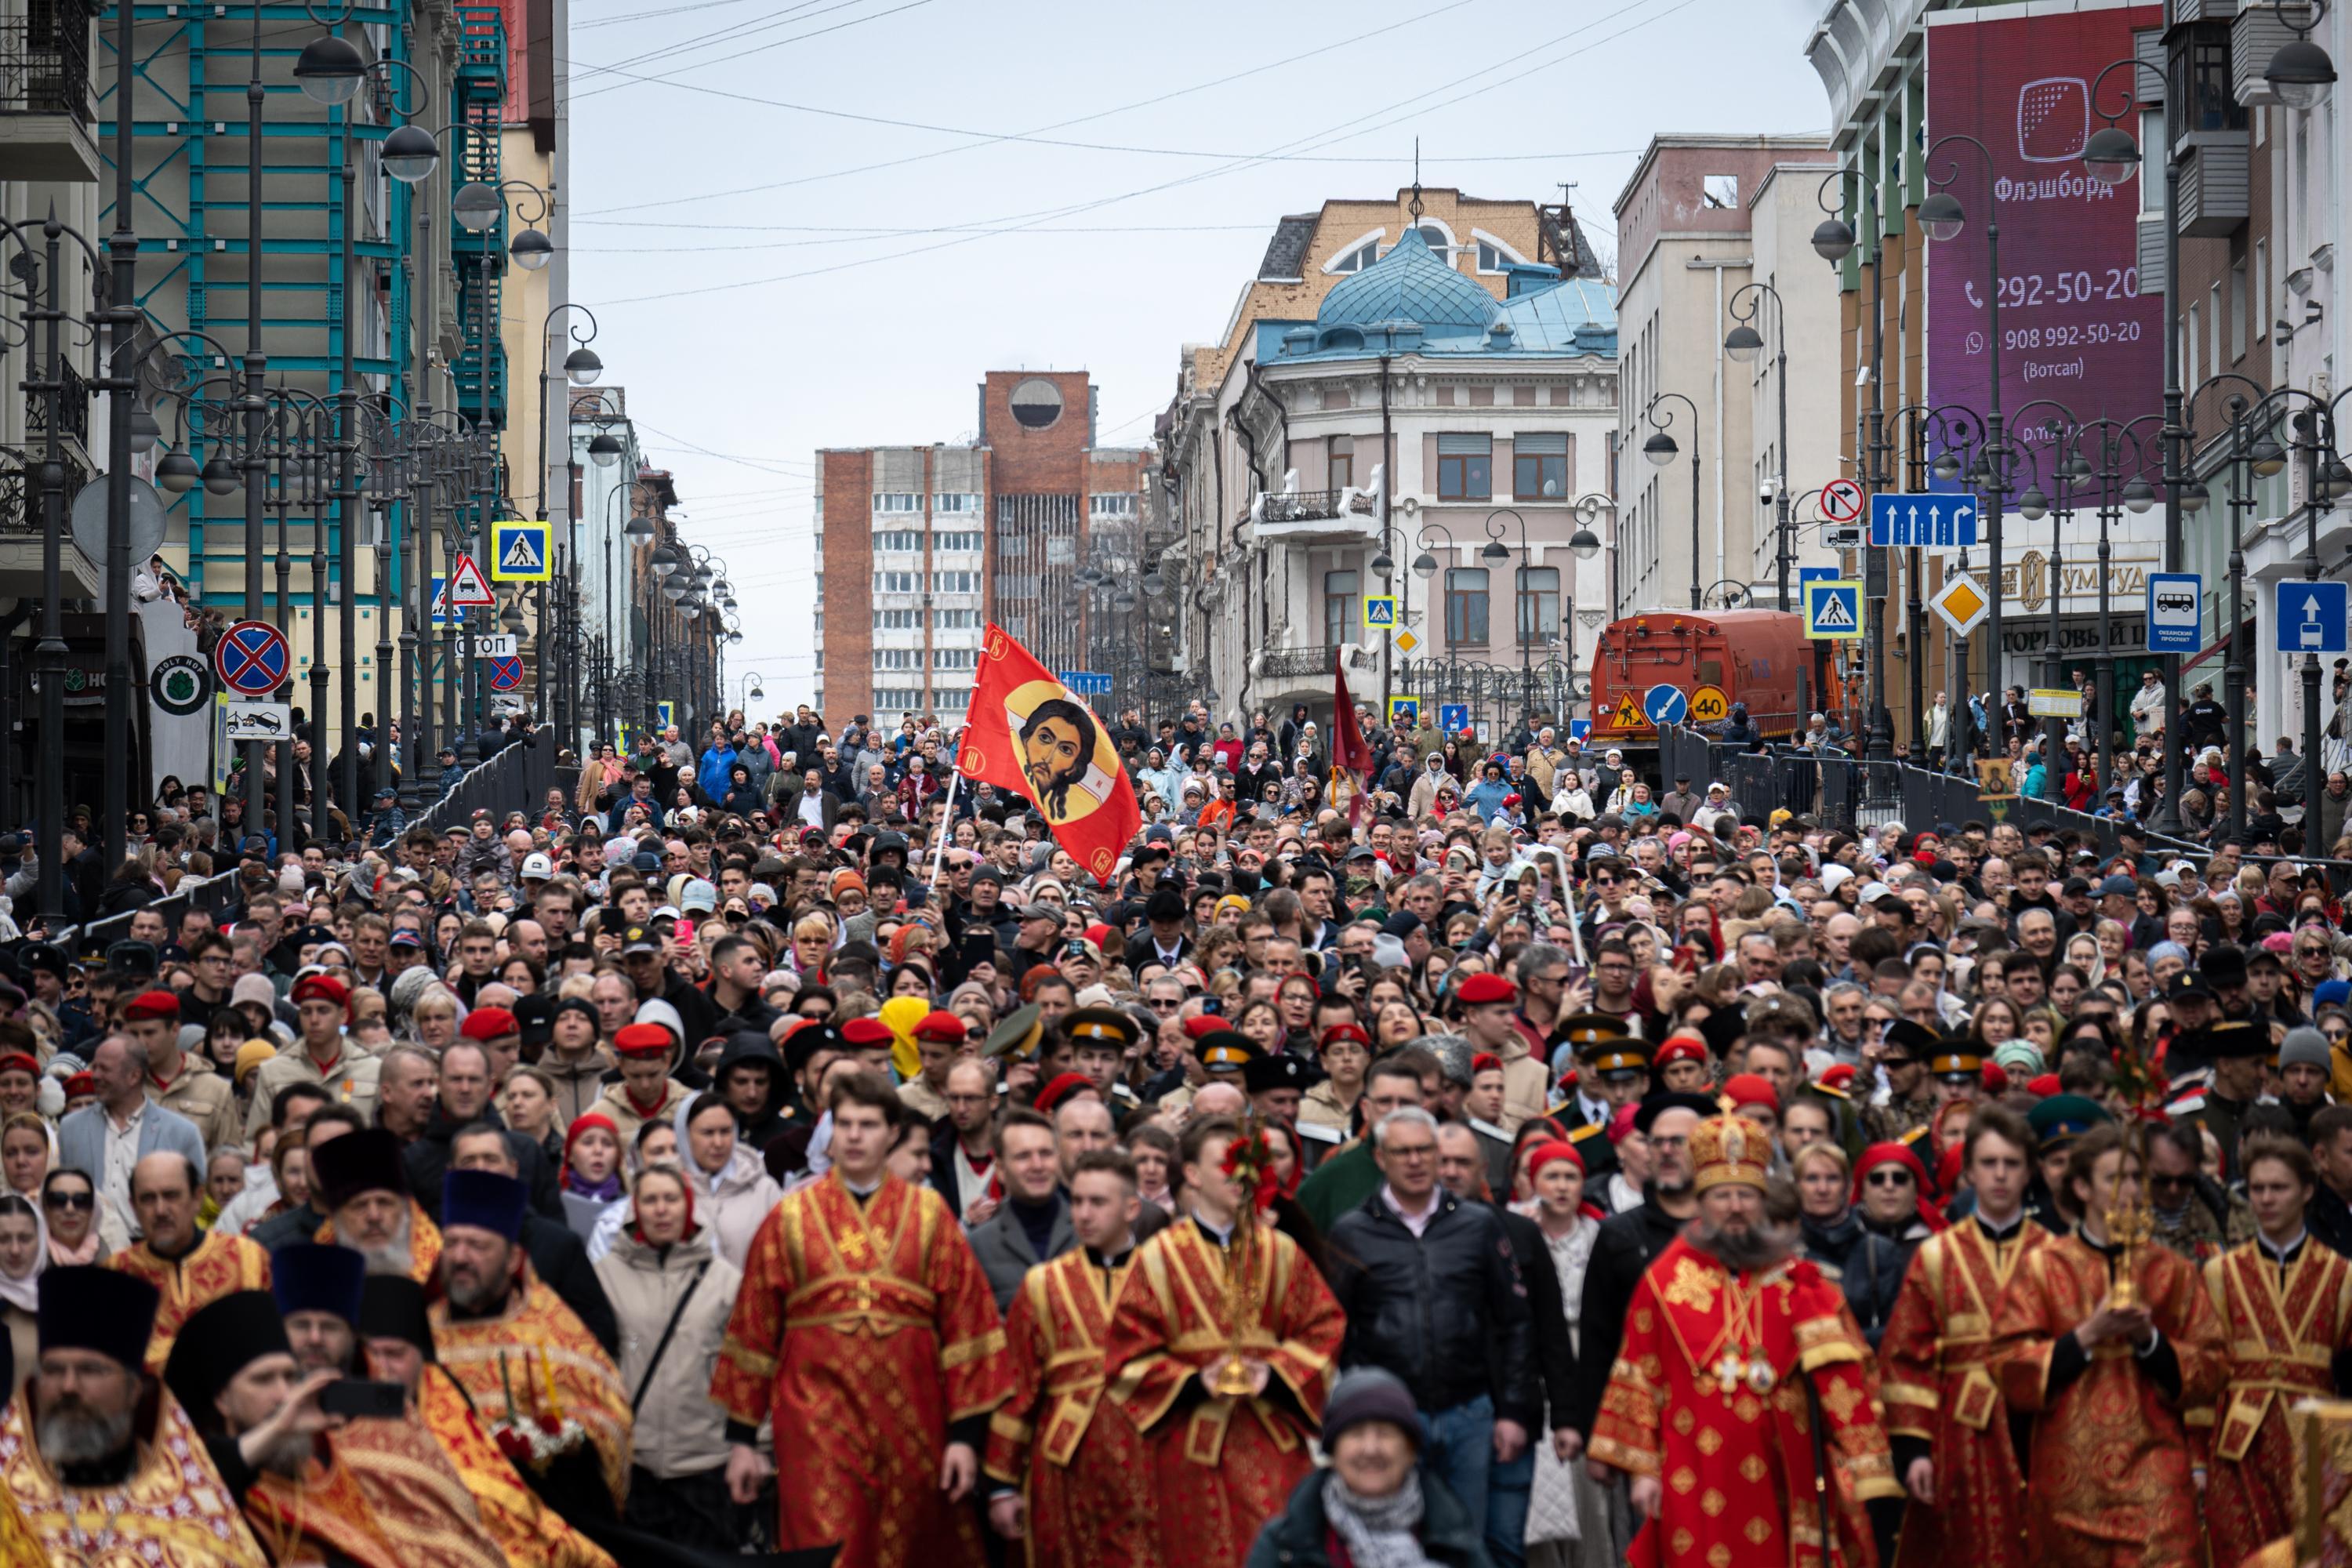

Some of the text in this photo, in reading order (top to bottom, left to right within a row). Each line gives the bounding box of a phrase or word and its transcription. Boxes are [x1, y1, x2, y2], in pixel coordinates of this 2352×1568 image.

[1994, 170, 2114, 202] Флэшборд
[1998, 267, 2137, 308] 292-50-20
[2005, 329, 2040, 350] 908
[2045, 321, 2140, 347] 992-50-20
[2024, 357, 2083, 383] (Вотсап)
[157, 658, 204, 673] HOLY HOP
[1696, 699, 1721, 715] 40
